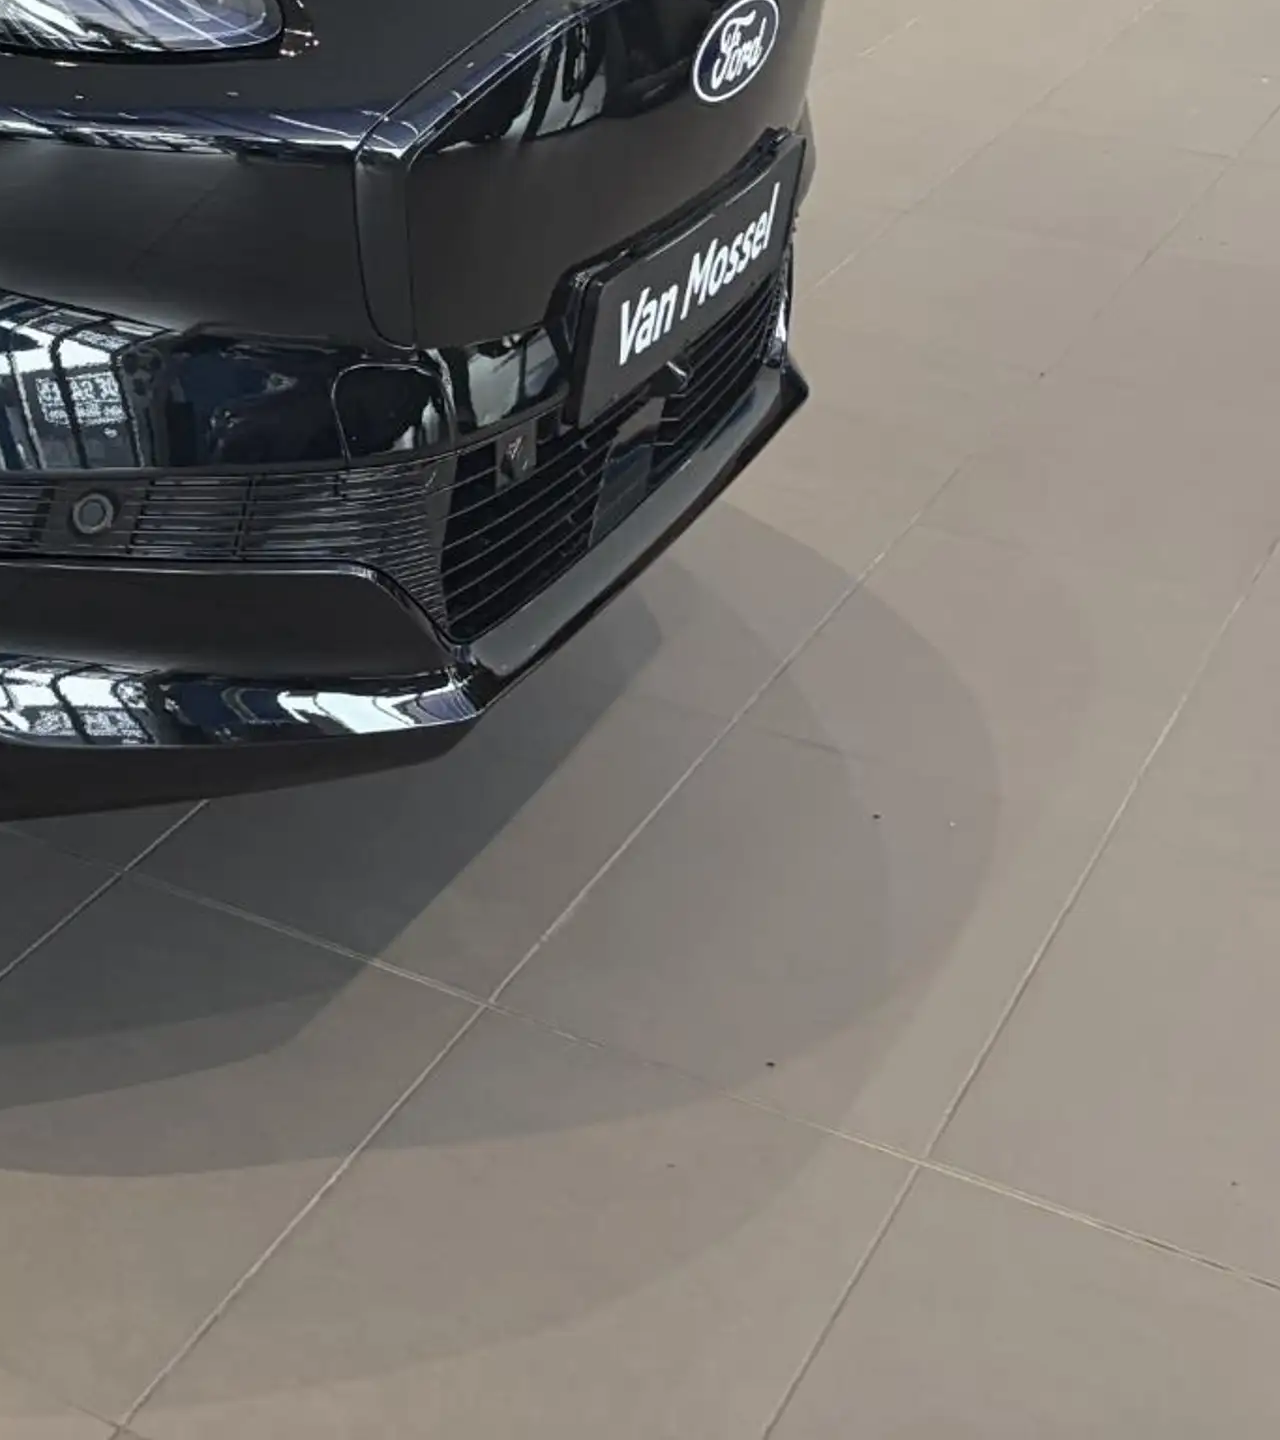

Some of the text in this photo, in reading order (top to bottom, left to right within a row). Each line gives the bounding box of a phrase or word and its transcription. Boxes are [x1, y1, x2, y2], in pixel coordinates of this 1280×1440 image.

[711, 9, 768, 90] Ford
[619, 181, 781, 366] Van Mossel
